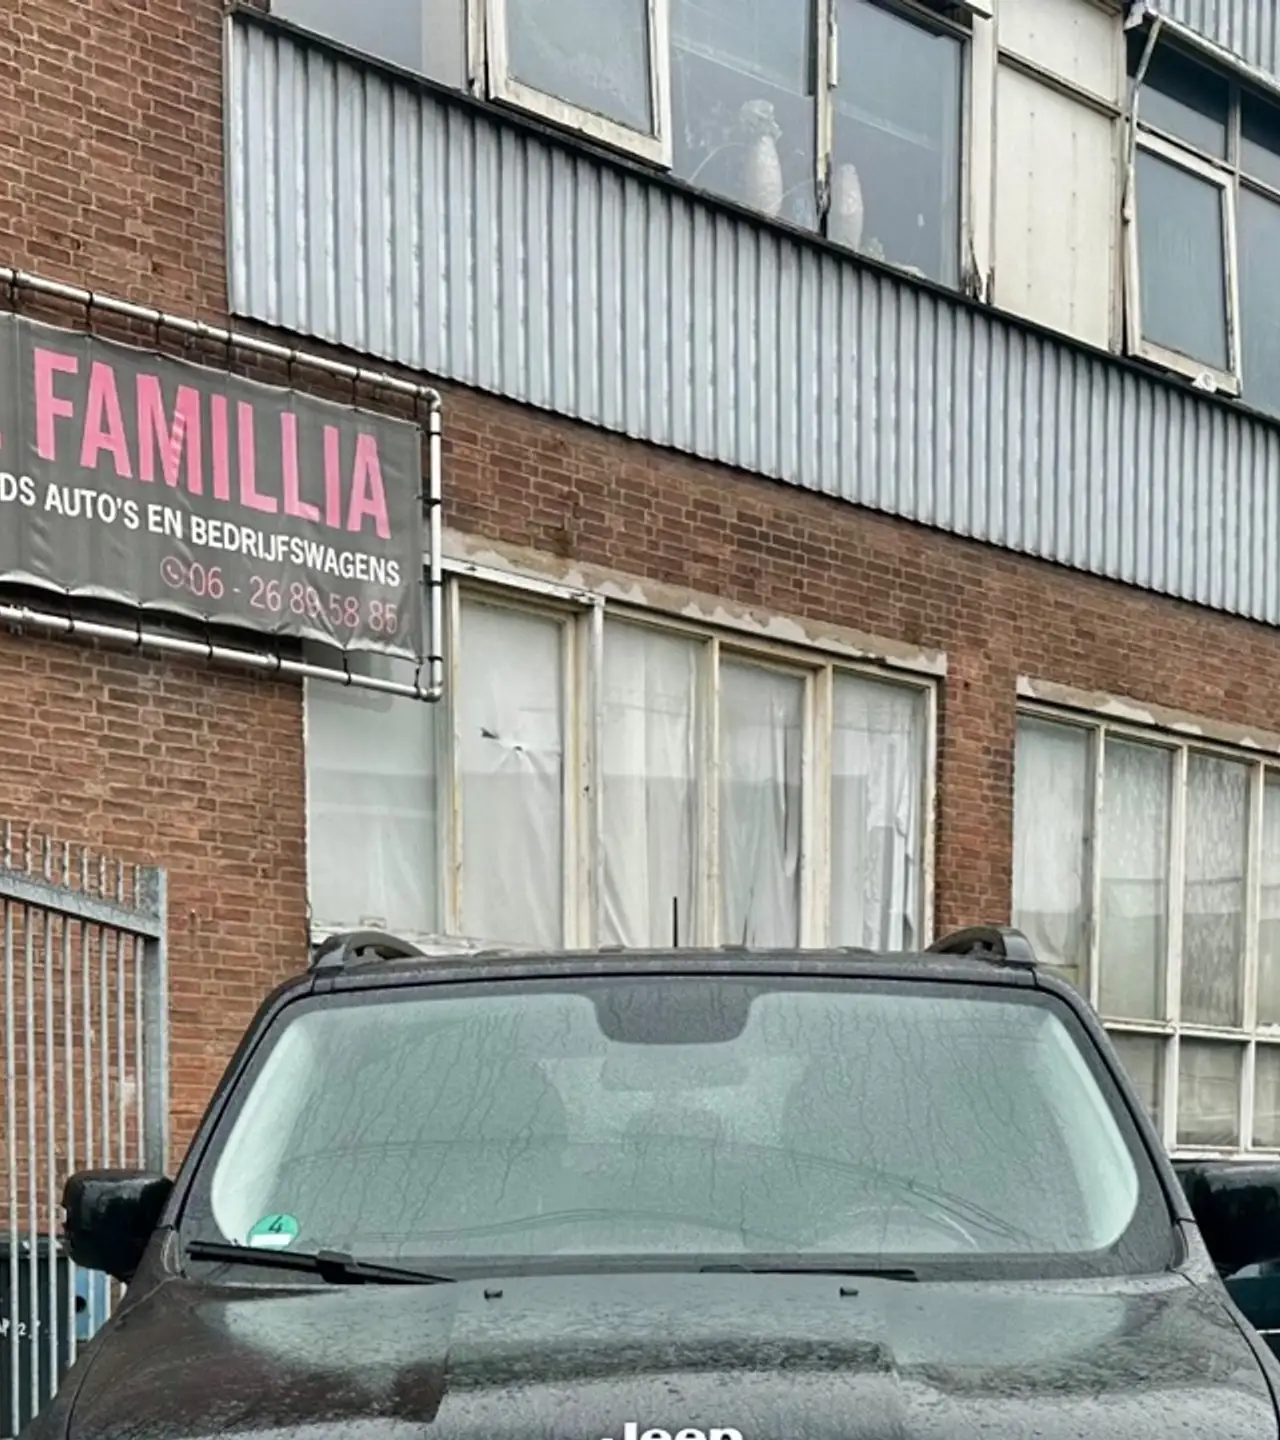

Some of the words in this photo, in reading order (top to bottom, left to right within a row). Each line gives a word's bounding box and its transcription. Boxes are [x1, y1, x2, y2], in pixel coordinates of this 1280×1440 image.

[33, 346, 393, 540] FAMILLIA
[44, 483, 140, 530] AUTO'S
[148, 503, 183, 540] EN
[190, 515, 401, 588] BEDRIJFSWAGENS
[249, 575, 282, 612] 26
[328, 592, 360, 628] 58
